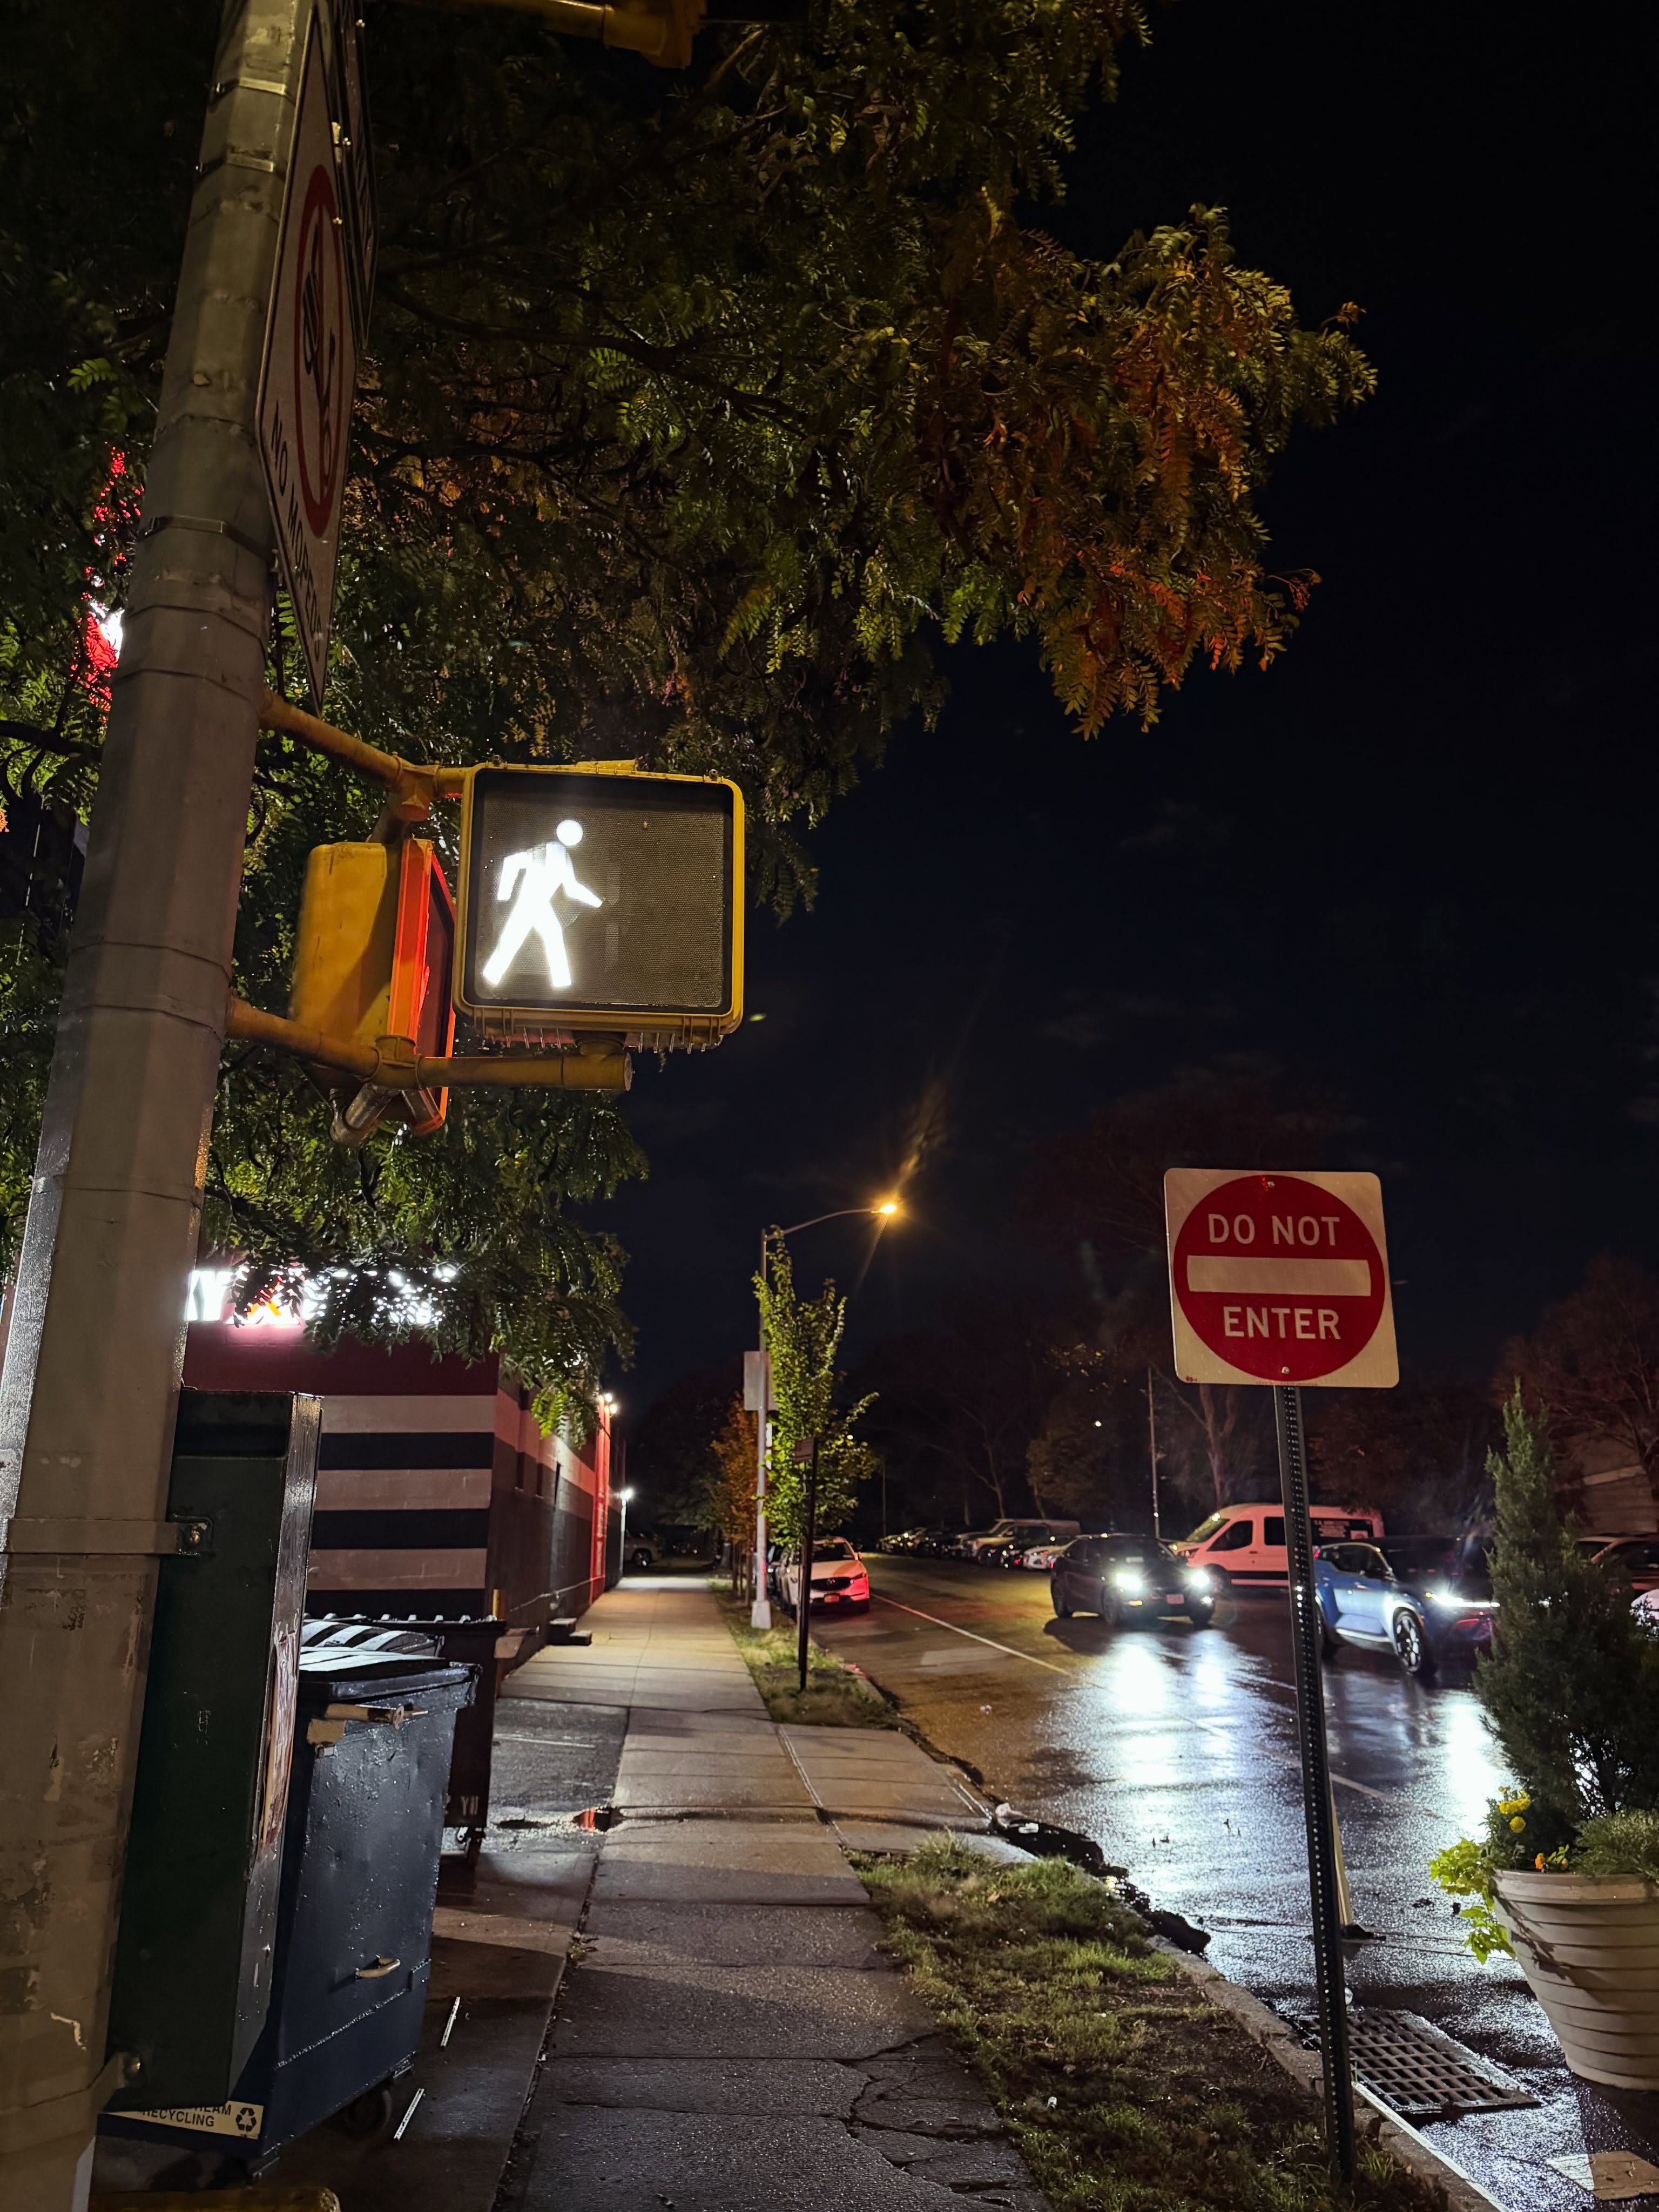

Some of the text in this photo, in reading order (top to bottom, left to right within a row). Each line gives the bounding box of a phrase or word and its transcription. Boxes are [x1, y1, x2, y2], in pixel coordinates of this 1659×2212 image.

[271, 399, 287, 496] NO
[1208, 1213, 1340, 1246] DO NOT
[1223, 1306, 1341, 1340] ENTER
